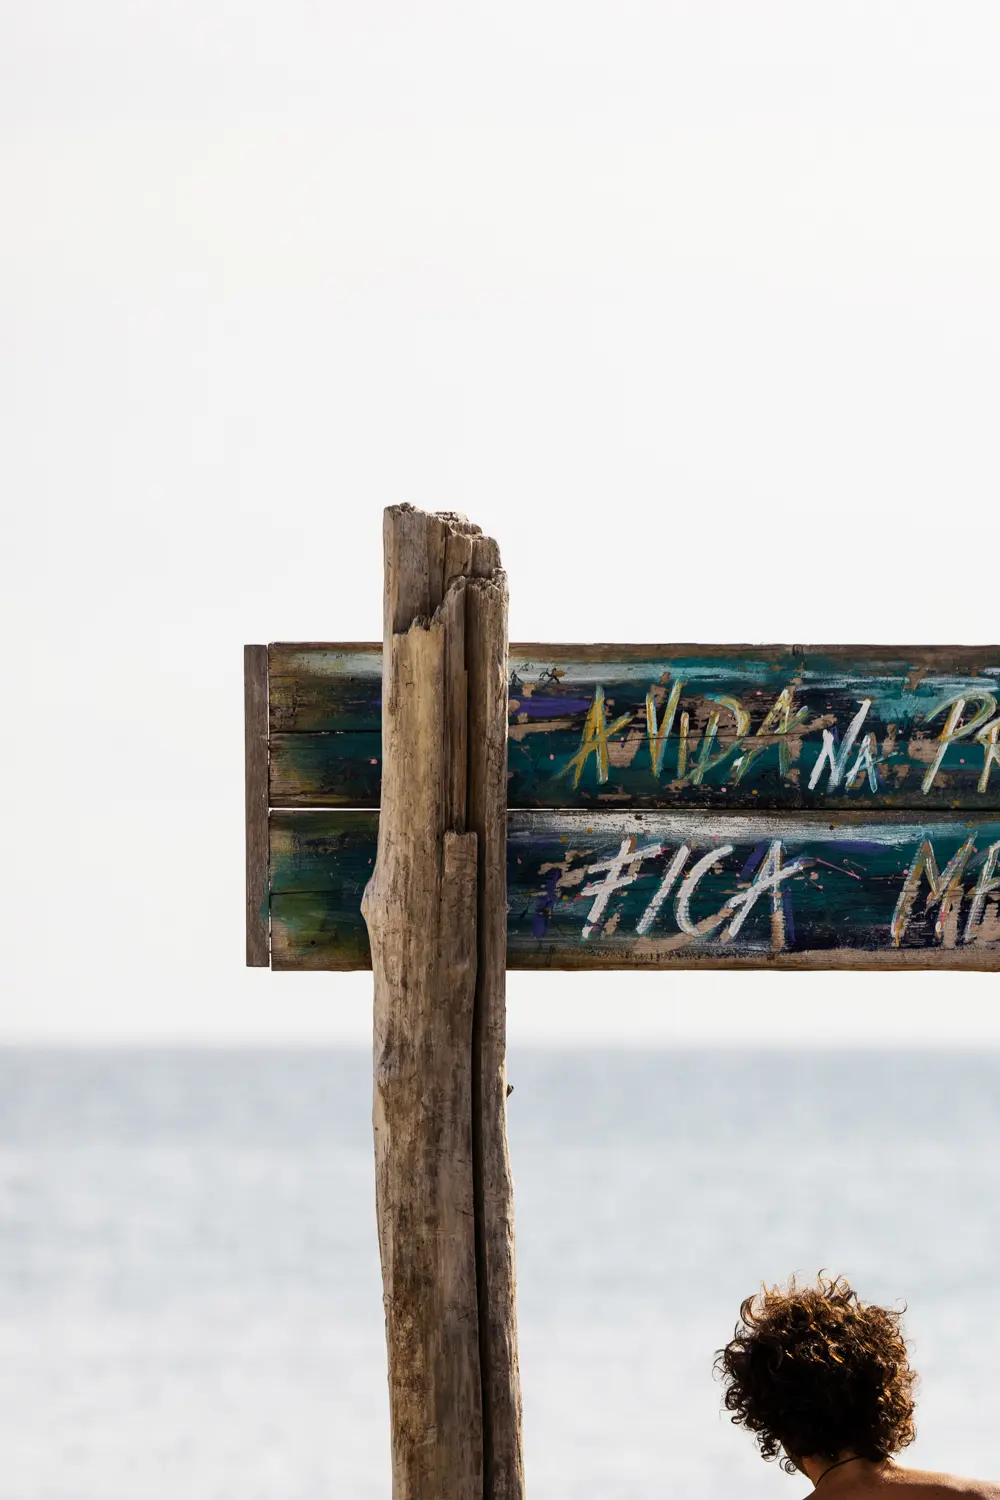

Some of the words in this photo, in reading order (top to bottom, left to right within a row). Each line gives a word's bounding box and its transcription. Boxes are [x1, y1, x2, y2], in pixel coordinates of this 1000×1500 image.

[558, 682, 633, 790] A
[645, 678, 809, 786] VIDA
[807, 699, 896, 793] NA
[575, 835, 817, 943] FICA
